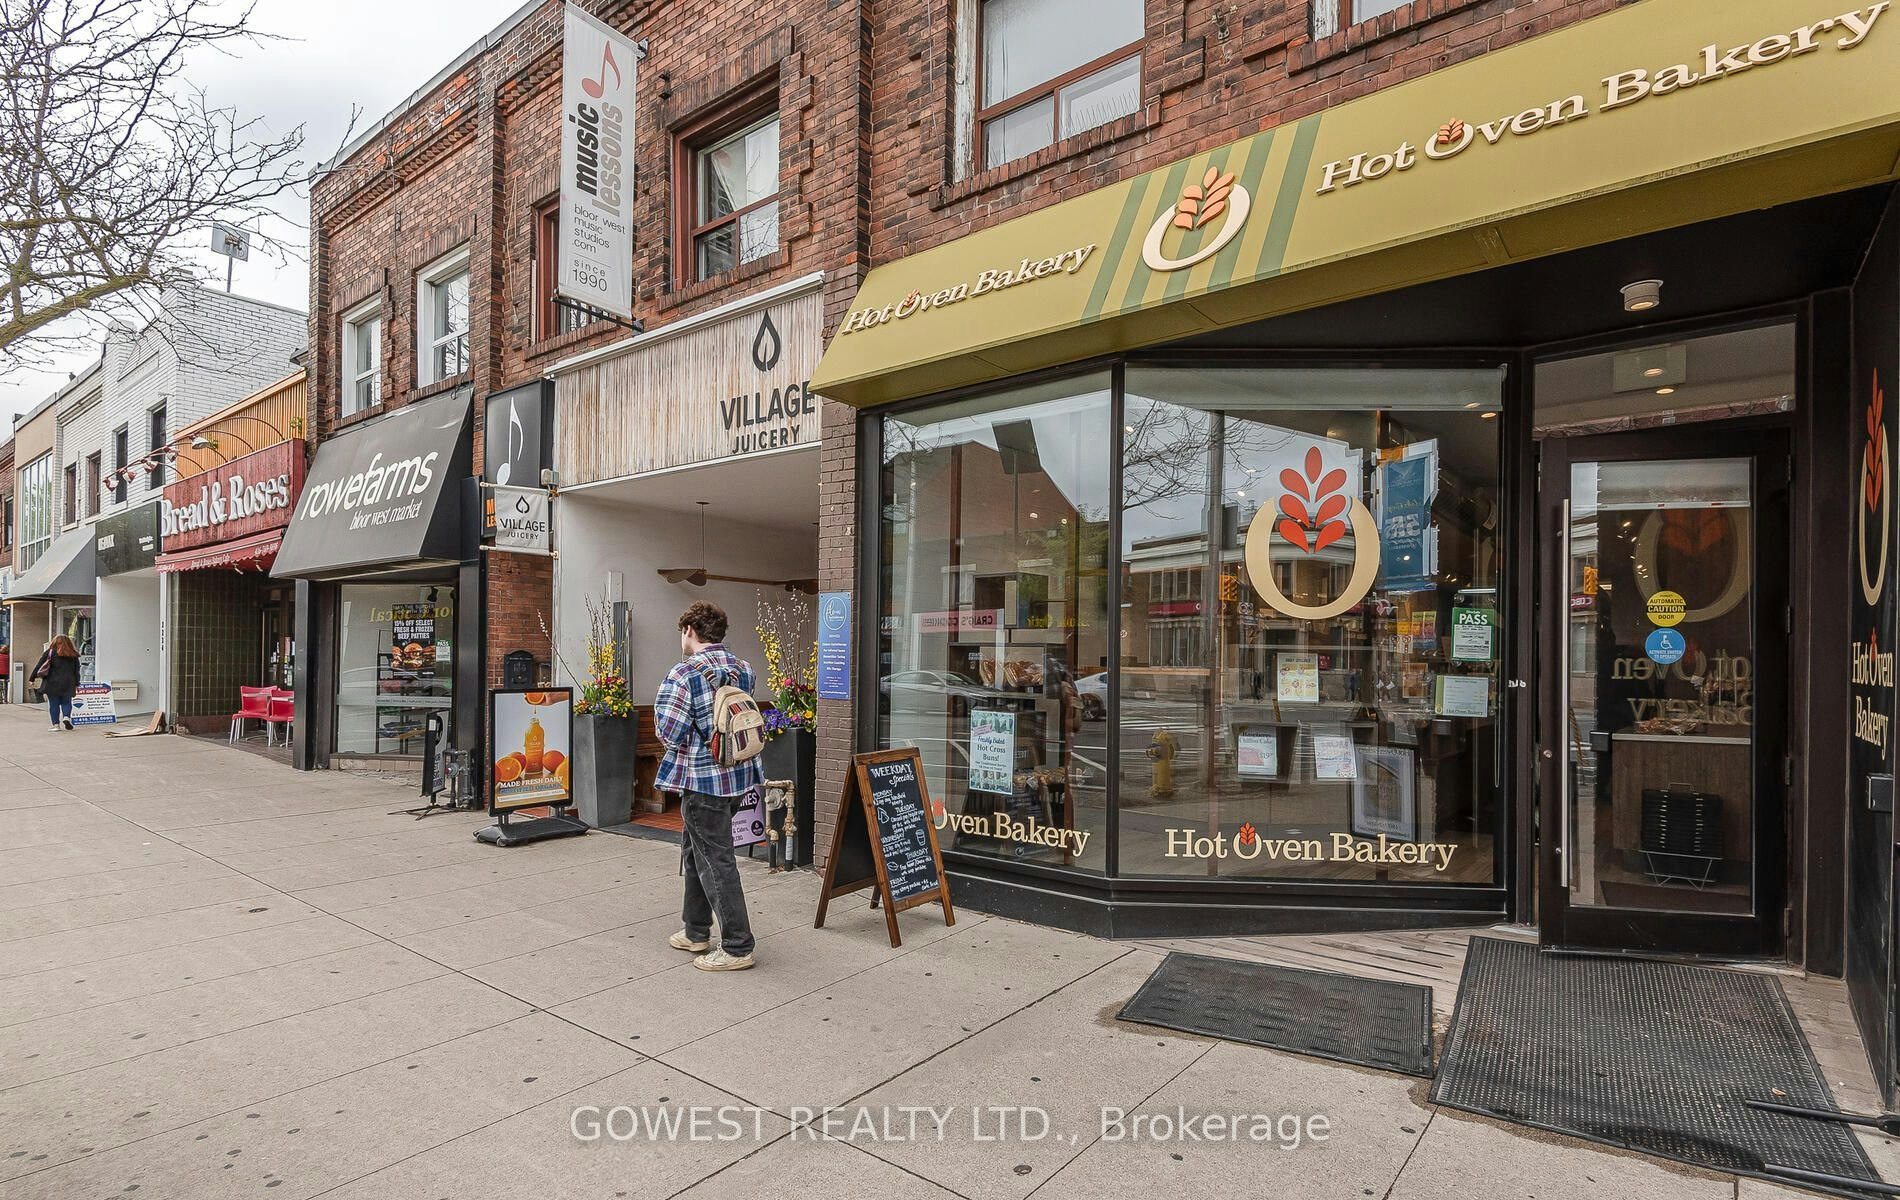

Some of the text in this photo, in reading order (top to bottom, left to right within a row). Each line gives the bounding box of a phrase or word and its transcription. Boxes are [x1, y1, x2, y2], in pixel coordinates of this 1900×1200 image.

[1316, 1, 1889, 195] Hot Oven Bakery
[569, 103, 599, 197] music
[592, 102, 622, 217] lessons
[574, 203, 626, 235] bloor west
[574, 217, 603, 235] music
[574, 227, 610, 249] studios
[573, 268, 608, 292] 1990
[574, 259, 606, 276] since
[841, 243, 1096, 335] Hot Oven Bakery
[720, 380, 815, 430] VILLAGE
[732, 424, 800, 454] JUICERY
[300, 452, 439, 520] rowefarms
[161, 474, 289, 537] Bread & Roses
[349, 499, 422, 530] bloor west market
[500, 518, 545, 532] VILLAGE
[506, 531, 539, 540] JUICERY
[1460, 614, 1488, 625] PASS
[1648, 605, 1684, 613] CAUTION
[1852, 641, 1893, 687] Hot Oven
[1855, 696, 1888, 760] Bakery
[989, 745, 1006, 753] Cross
[500, 775, 563, 788] MADE FRESH DAILY
[871, 763, 912, 778] WEEKDAY
[889, 772, 915, 787] Specials
[993, 811, 1090, 857] Bakery
[905, 847, 929, 860] THURSDAY
[1164, 829, 1458, 871] Hot Oven Bakery
[890, 876, 906, 885] FRIDAY
